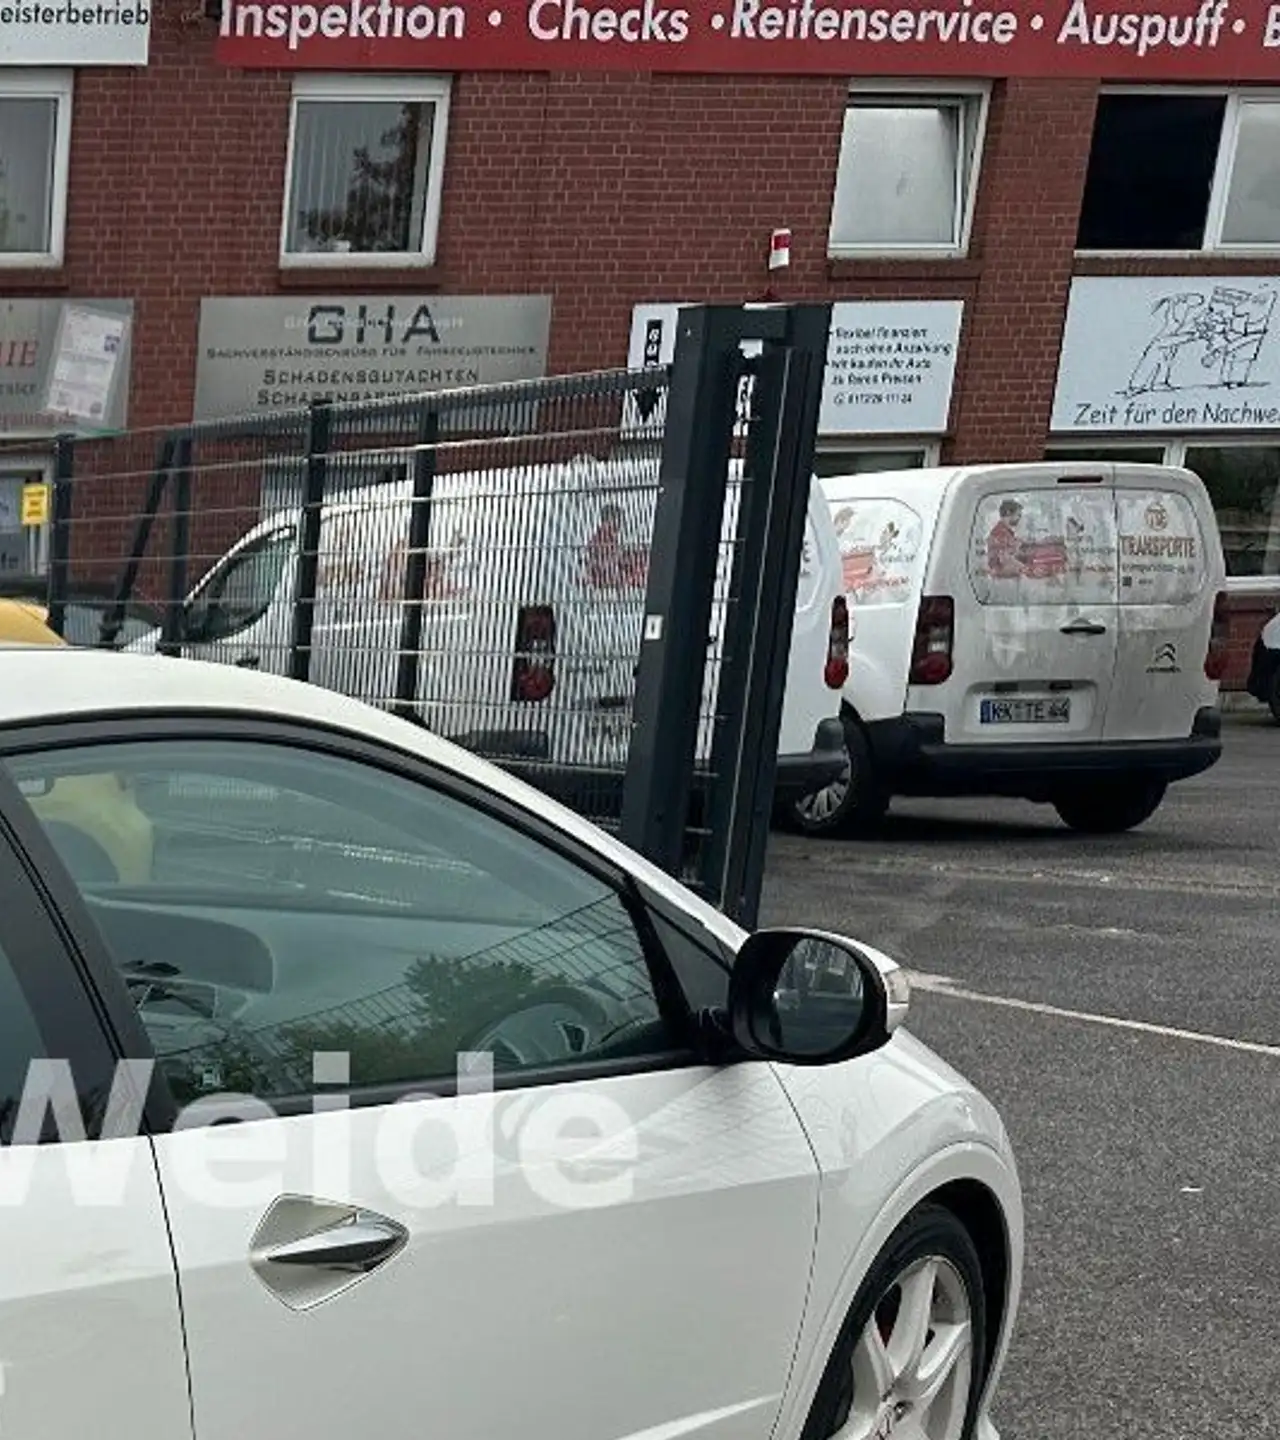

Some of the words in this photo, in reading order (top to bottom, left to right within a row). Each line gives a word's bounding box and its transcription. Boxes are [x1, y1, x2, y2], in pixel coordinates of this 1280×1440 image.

[219, 0, 465, 49] Inspektion
[529, 0, 690, 42] Checks
[730, 0, 1017, 44] Reifenservice
[1057, 0, 1227, 56] Auspuff
[307, 304, 440, 344] GHA
[262, 368, 479, 386] SCHADENSGUTACHTEN
[1073, 402, 1118, 426] Zeit
[1123, 401, 1157, 426] für
[1162, 401, 1197, 424] den
